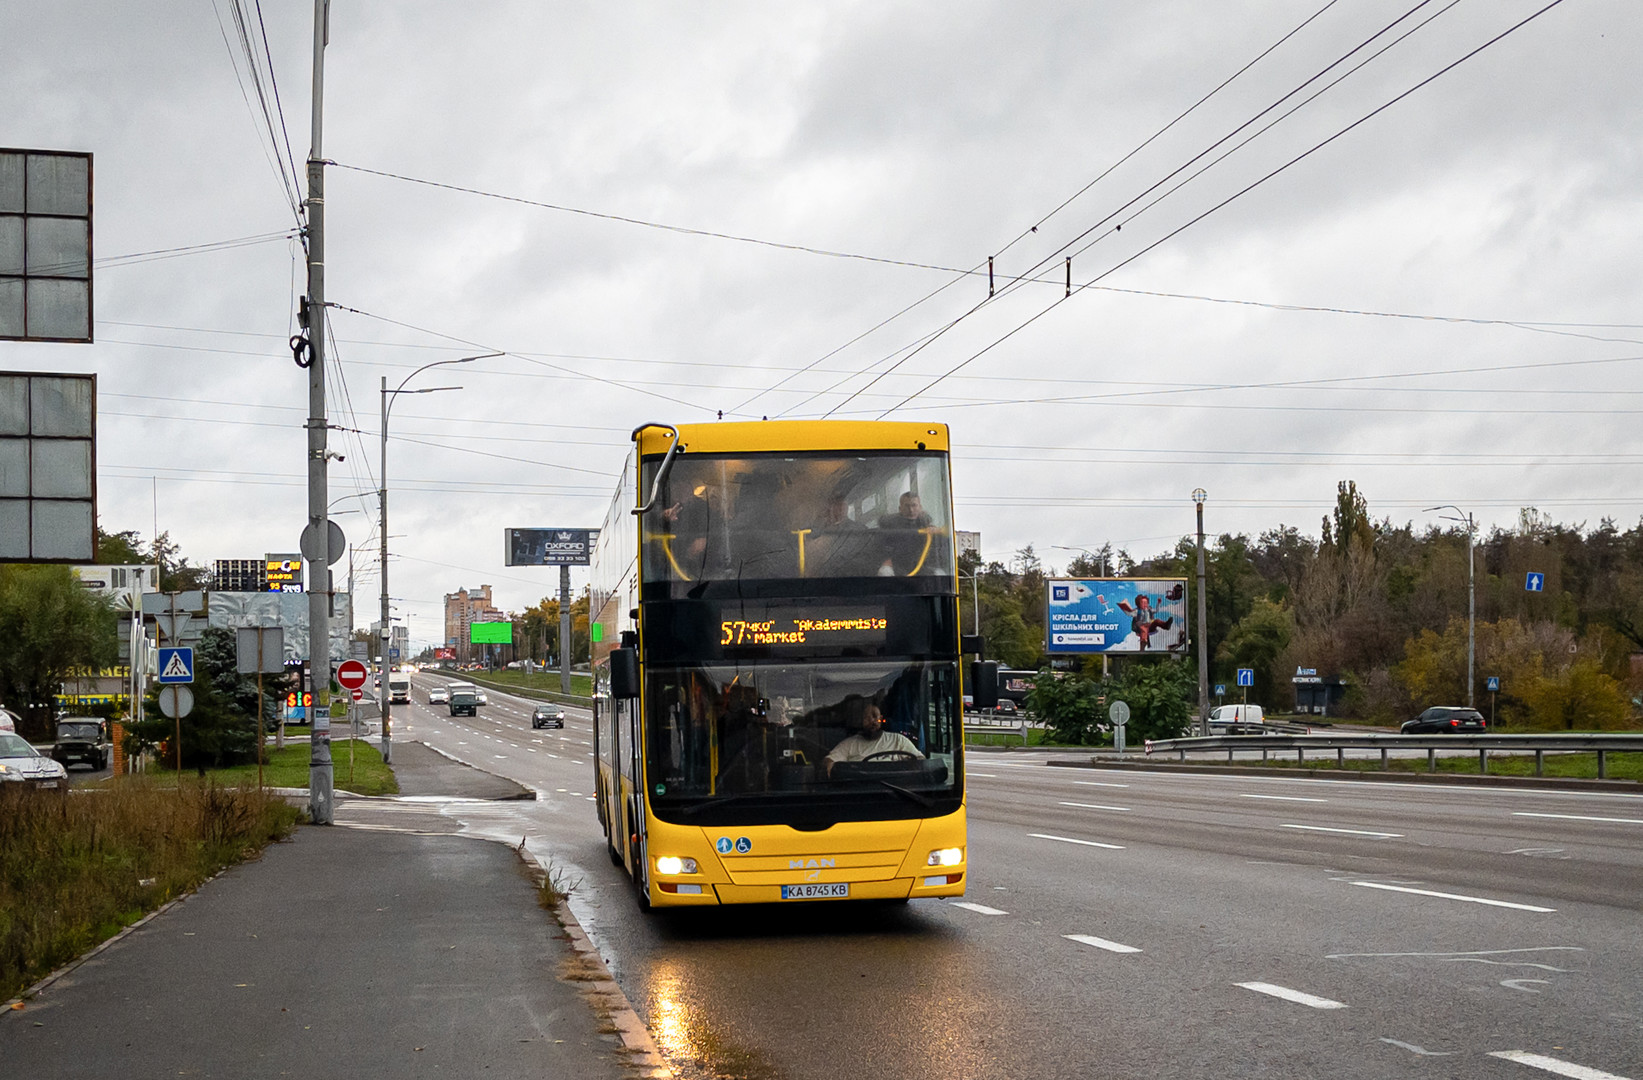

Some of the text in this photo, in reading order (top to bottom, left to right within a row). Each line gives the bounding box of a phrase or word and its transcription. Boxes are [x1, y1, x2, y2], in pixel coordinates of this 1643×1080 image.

[266, 560, 301, 572] БРСМ
[269, 582, 280, 590] 95
[1081, 614, 1097, 622] ДЛЯ
[721, 620, 746, 645] 57
[789, 858, 835, 869] MAN
[788, 885, 847, 897] KA 8745 KB
